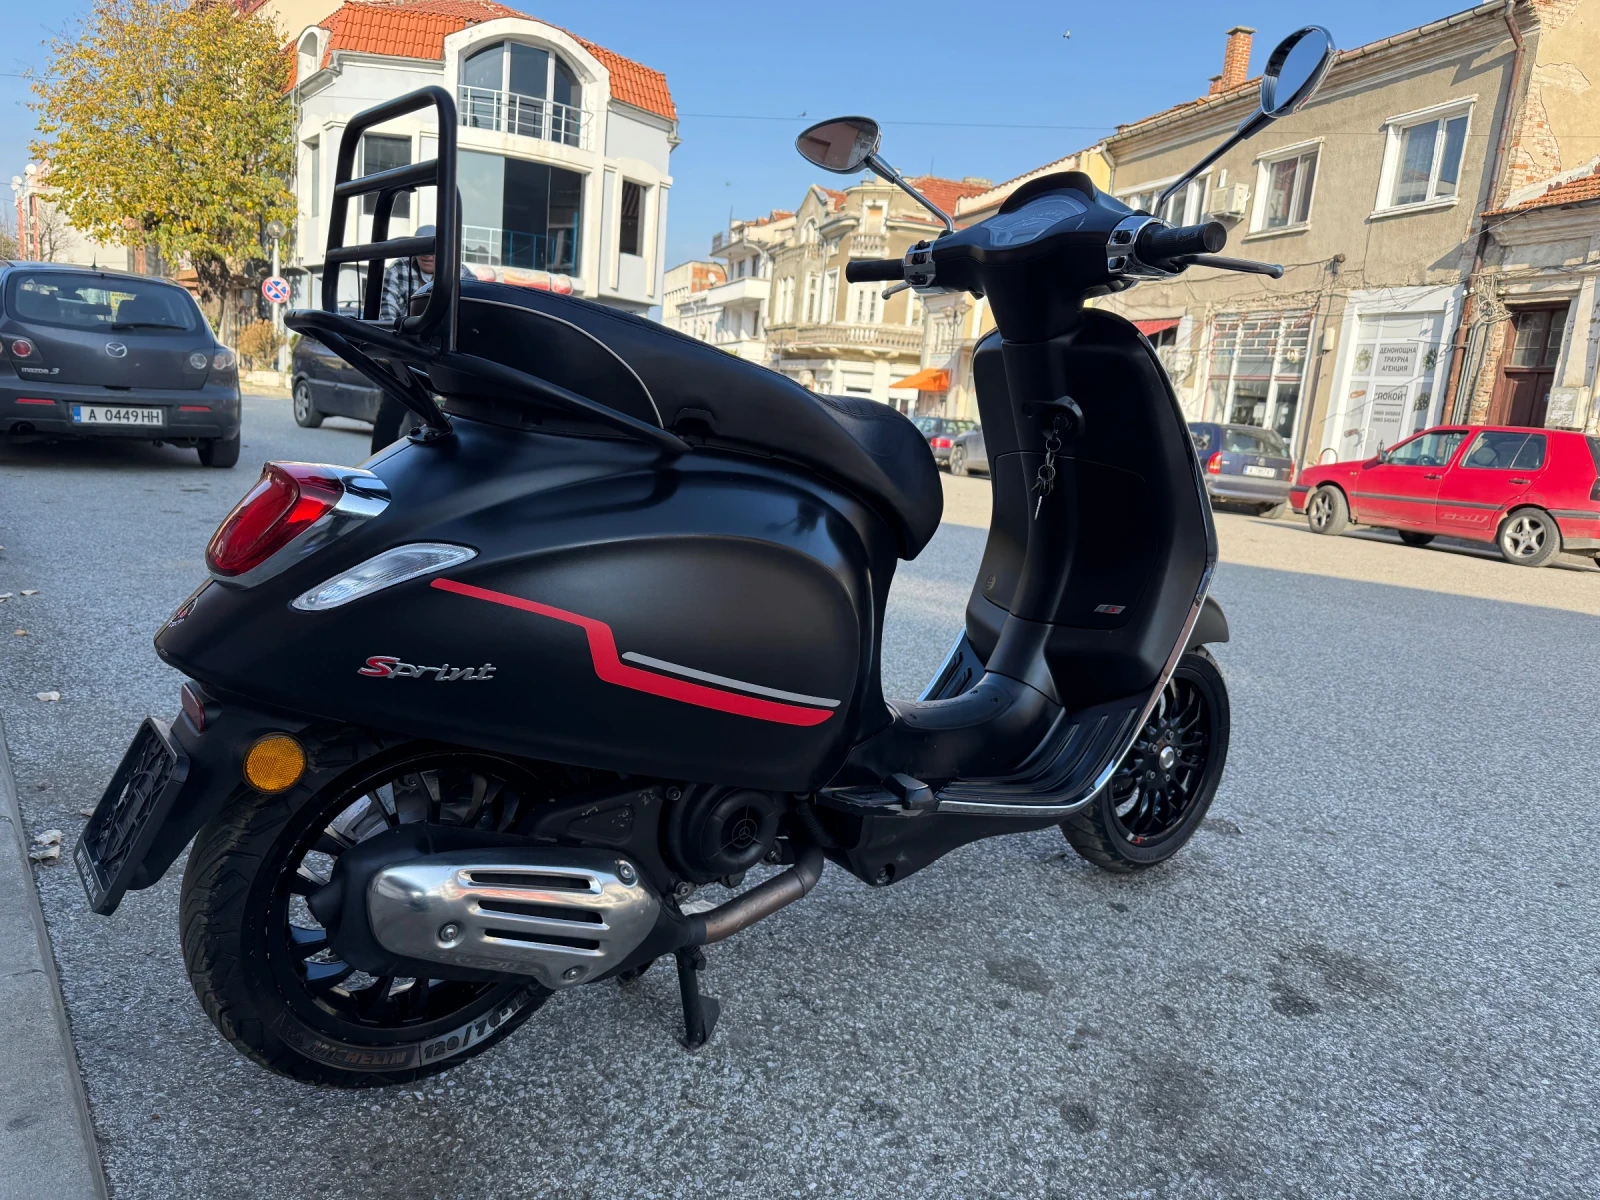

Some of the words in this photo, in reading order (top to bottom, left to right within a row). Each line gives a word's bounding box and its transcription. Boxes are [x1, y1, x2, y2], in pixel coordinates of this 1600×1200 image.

[1379, 346, 1417, 354] ДЕНОНОЩНА
[88, 409, 97, 421] A
[105, 409, 138, 422] 0449
[357, 655, 497, 681] Sprint
[308, 1040, 408, 1065] MICHELIN
